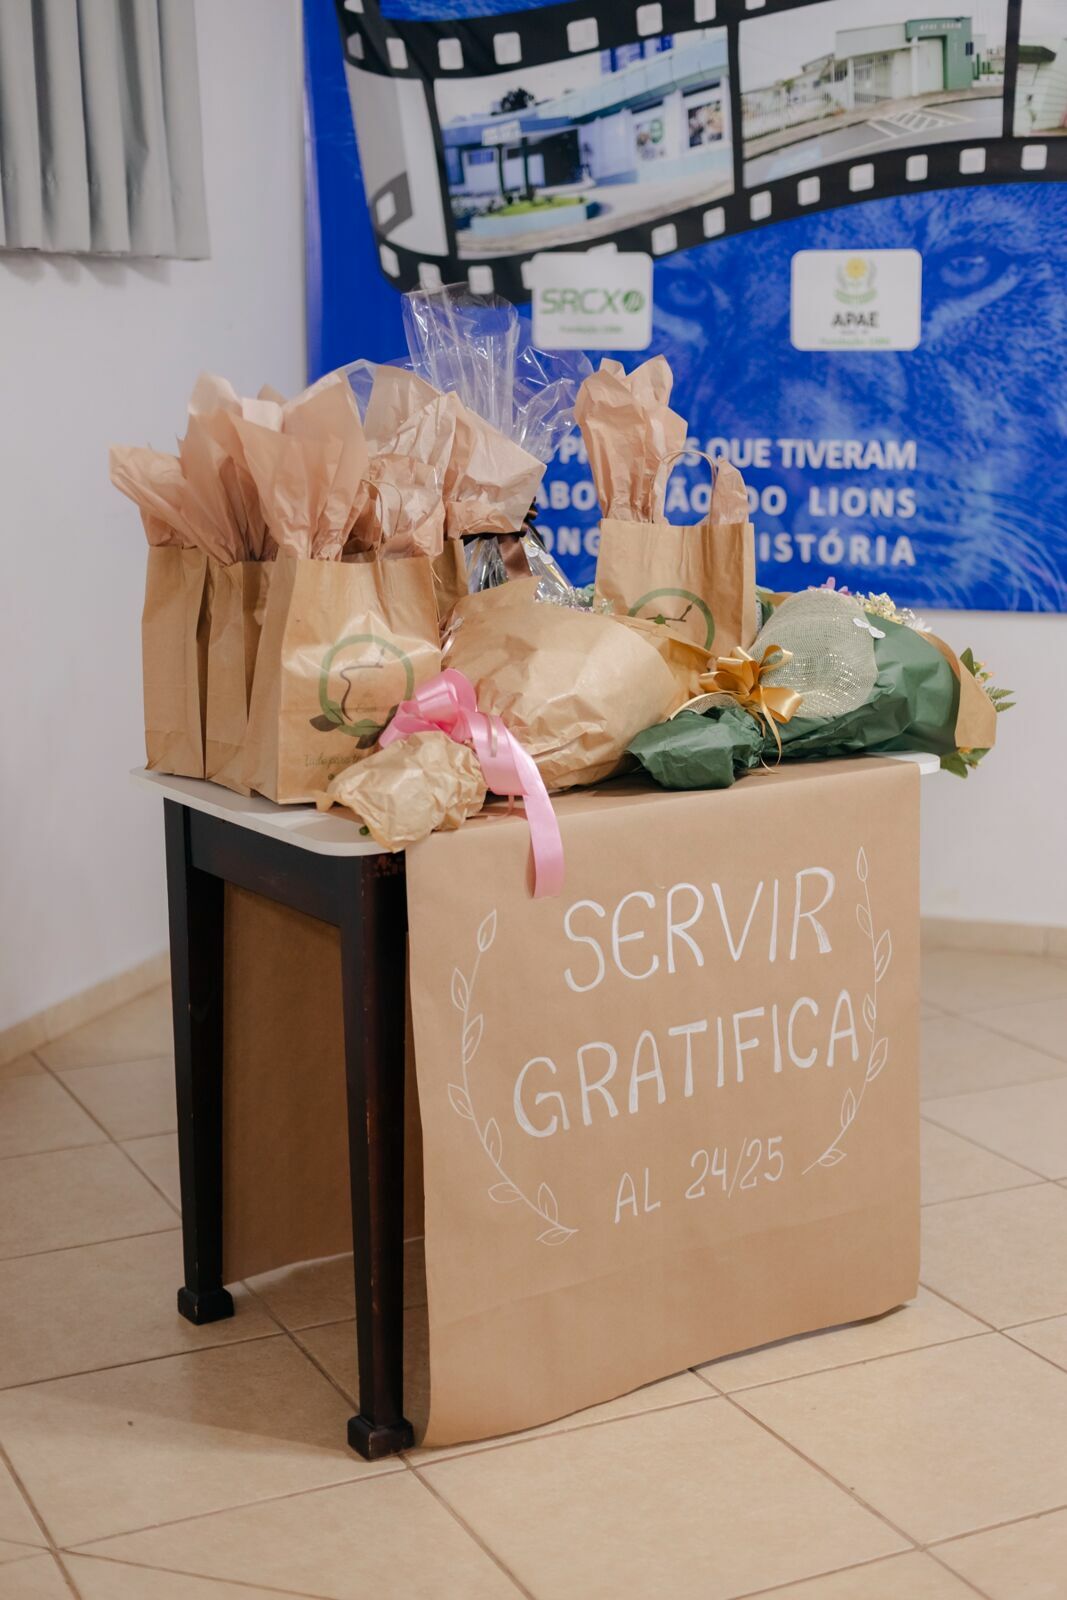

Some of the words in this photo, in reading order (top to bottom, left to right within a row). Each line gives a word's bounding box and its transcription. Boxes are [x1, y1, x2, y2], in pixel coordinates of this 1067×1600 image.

[831, 311, 880, 328] APAE
[705, 436, 772, 468] QUE
[776, 438, 917, 471] TIVERAM
[808, 486, 917, 518] LIONS
[758, 527, 916, 566] ISTÓRIA
[563, 866, 836, 993] SERVIR
[513, 988, 860, 1138] GRATIFICA
[614, 1167, 662, 1224] AL
[684, 1135, 785, 1200] 24/25
